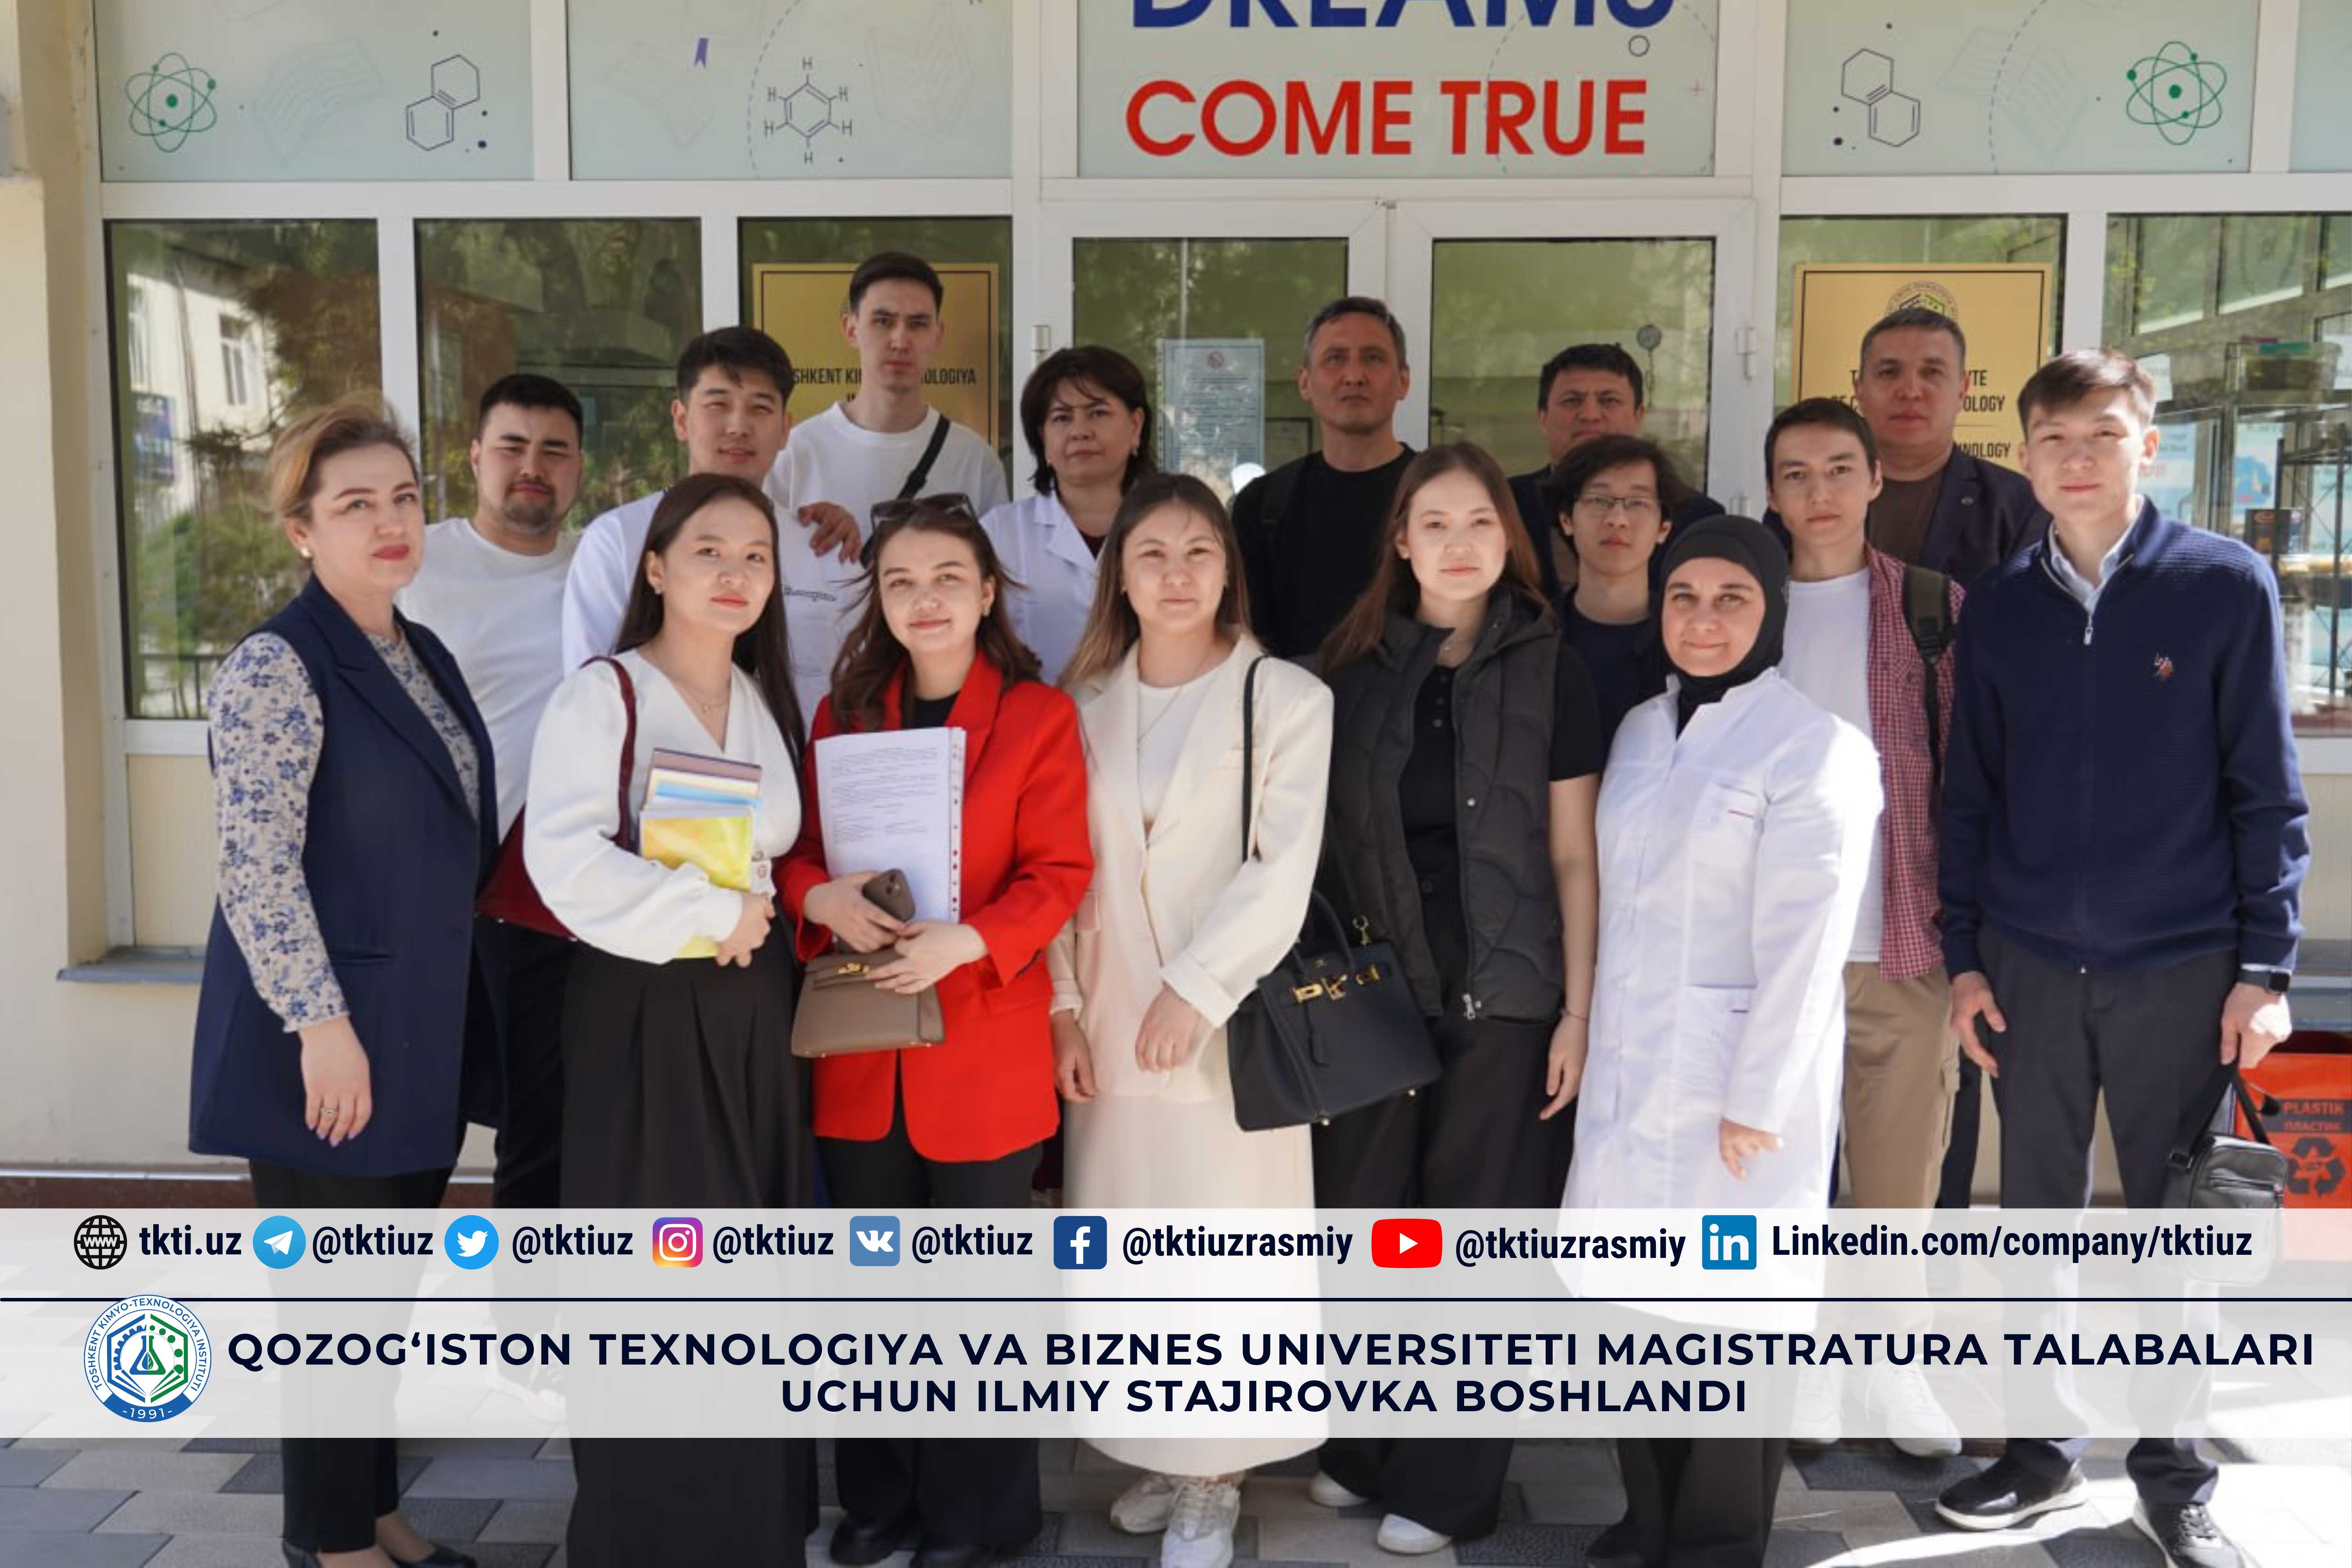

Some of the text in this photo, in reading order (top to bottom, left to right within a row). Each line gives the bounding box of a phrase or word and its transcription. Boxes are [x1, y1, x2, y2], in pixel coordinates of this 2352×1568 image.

[1126, 79, 1647, 156] COME TRUE
[792, 368, 842, 385] SHKENT
[2284, 1102, 2343, 1115] PLASTIK
